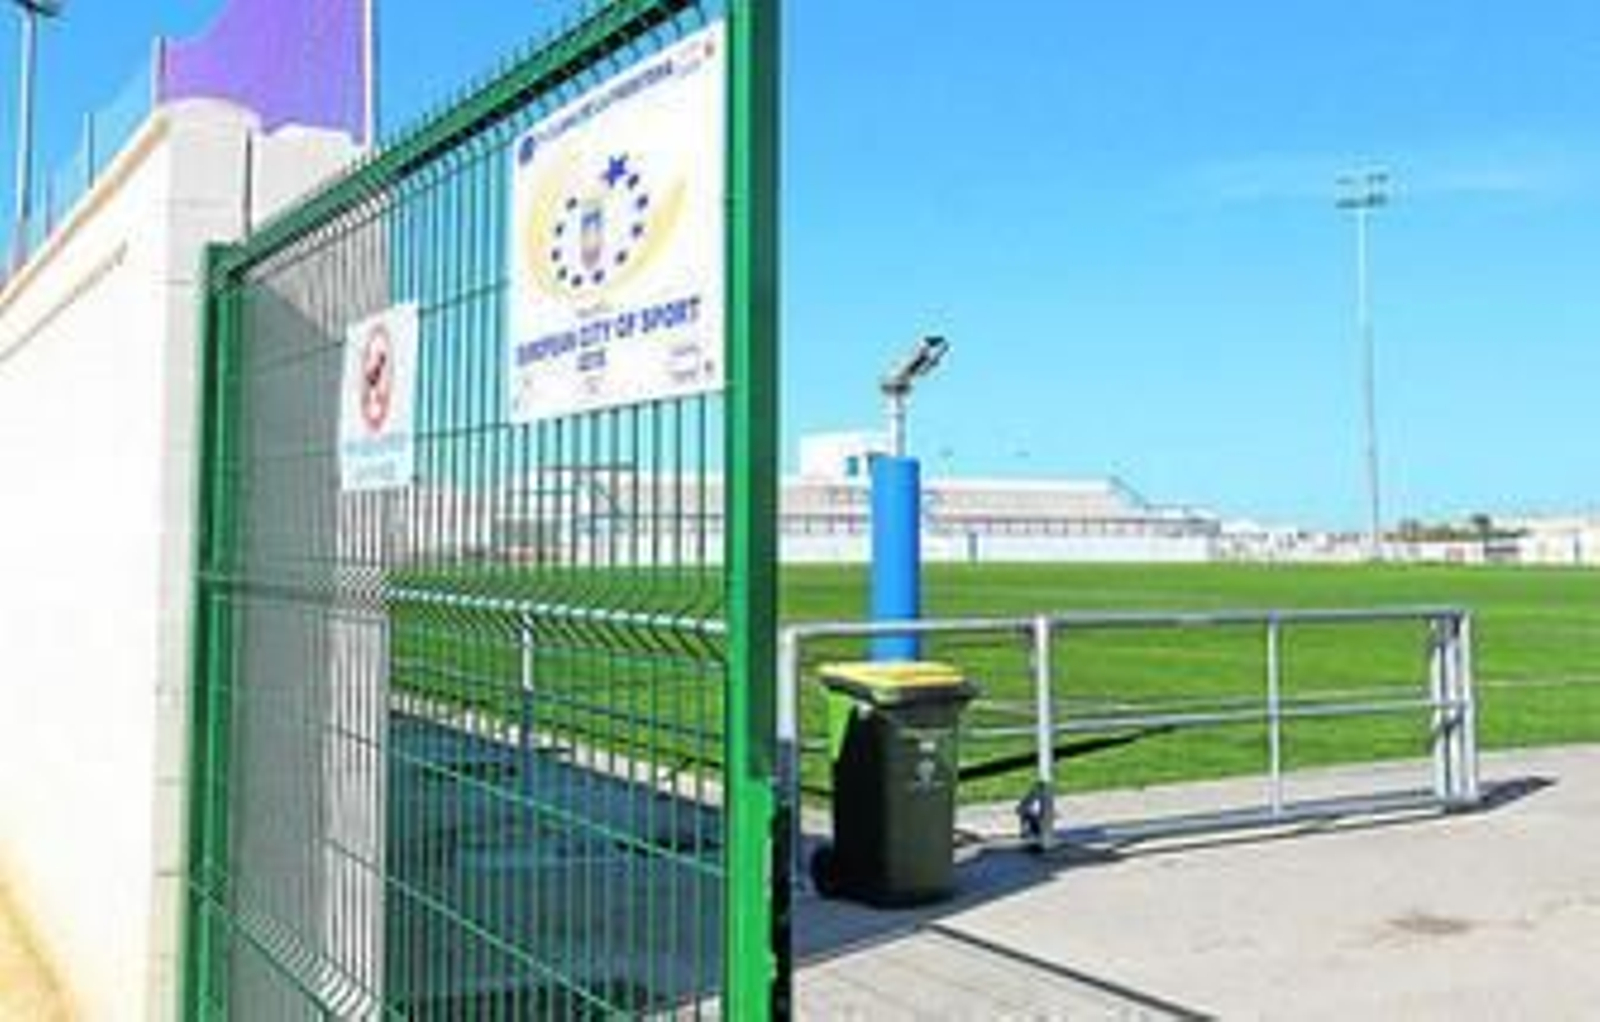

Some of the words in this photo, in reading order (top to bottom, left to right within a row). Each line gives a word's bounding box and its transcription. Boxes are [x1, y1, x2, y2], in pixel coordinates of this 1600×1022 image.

[579, 320, 611, 348] CITY
[615, 312, 635, 337] OF
[641, 297, 700, 333] SPORT
